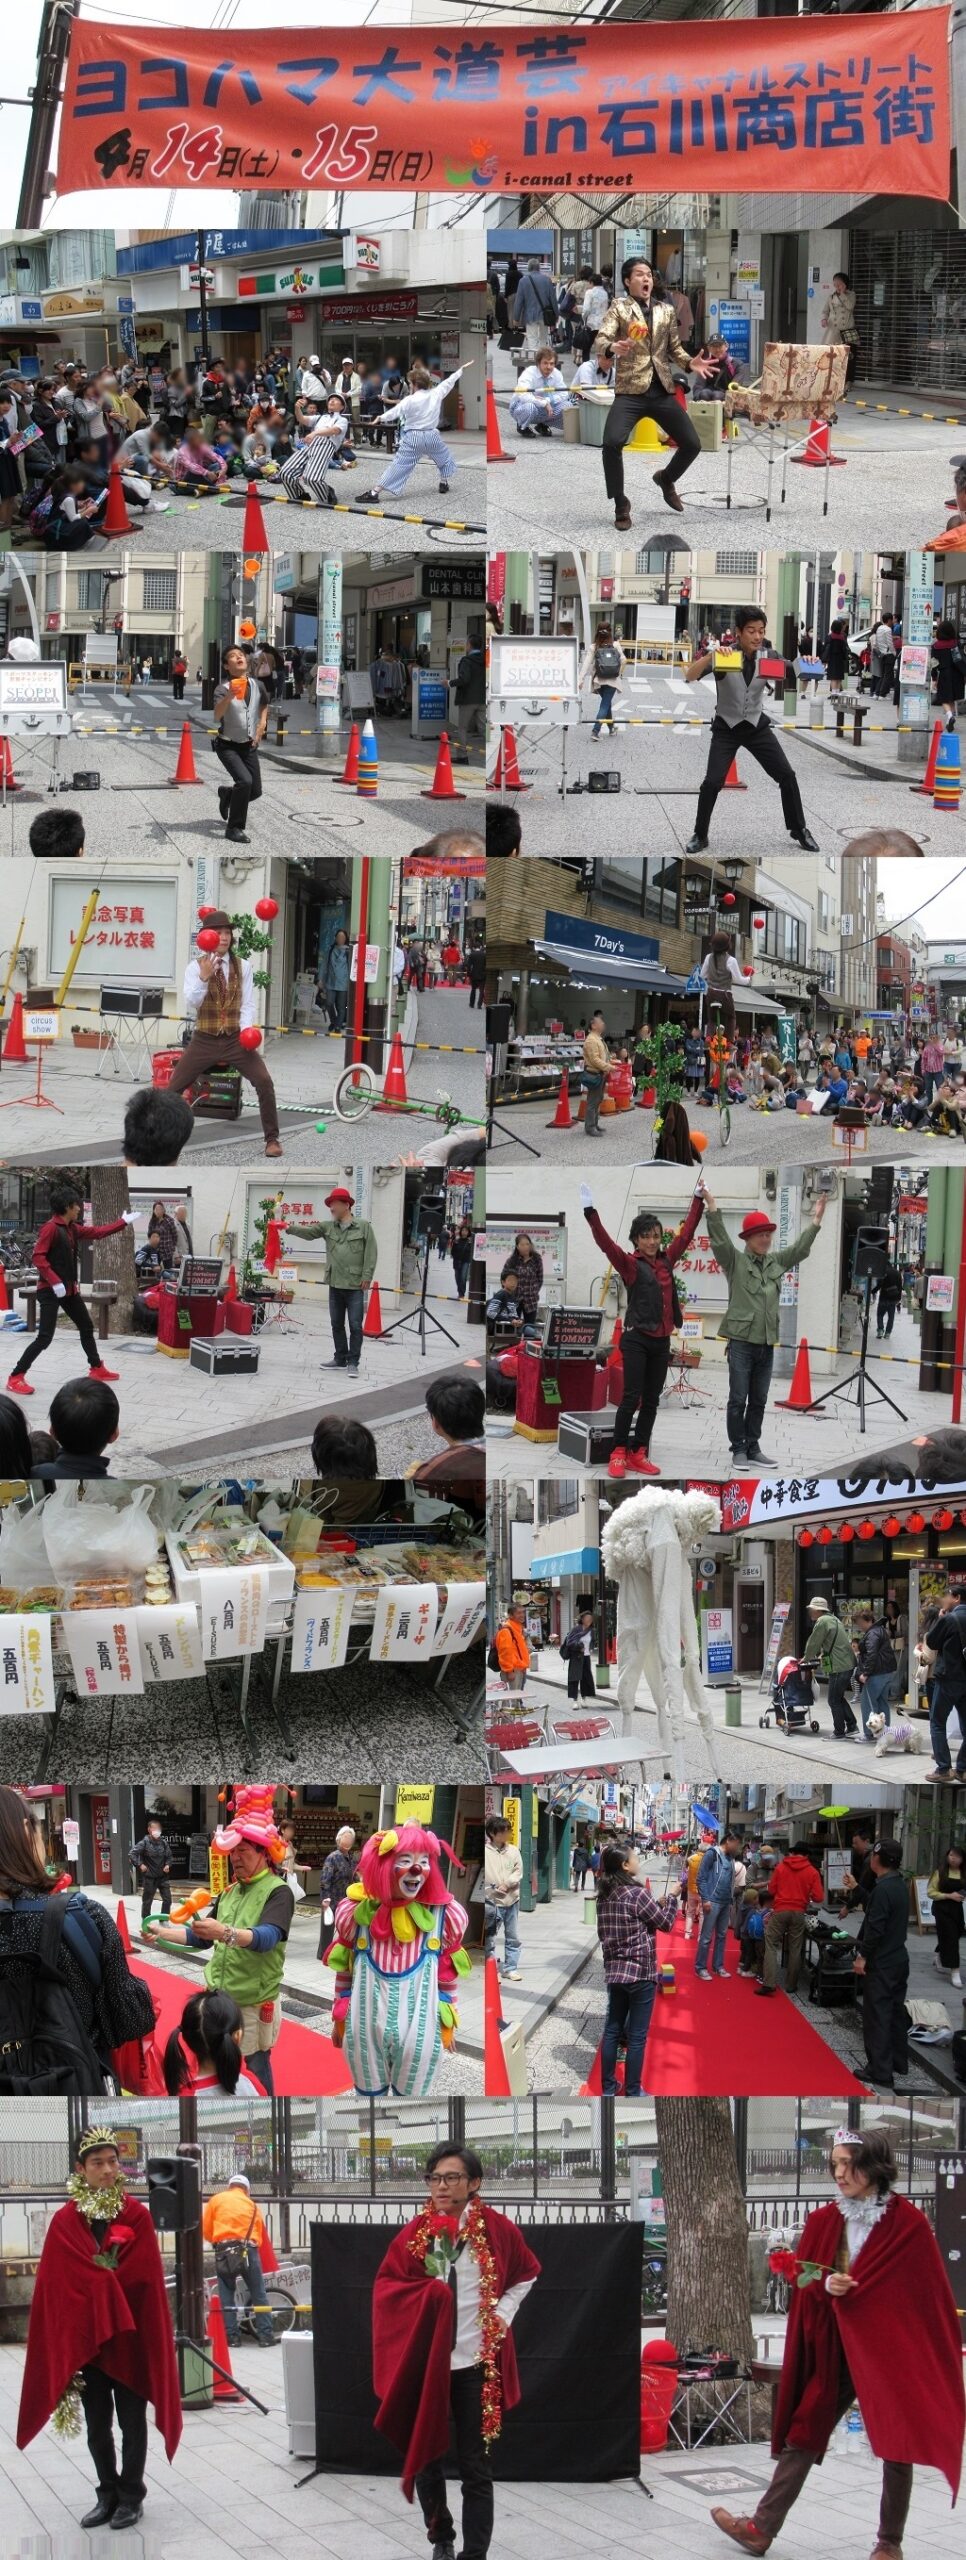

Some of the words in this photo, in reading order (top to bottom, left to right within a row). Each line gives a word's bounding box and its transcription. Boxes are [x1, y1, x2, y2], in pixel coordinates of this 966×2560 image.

[73, 35, 588, 118] ヨコハマ大道芸
[602, 54, 934, 98] アイキャナルストリート
[504, 171, 572, 187] i-canal
[576, 172, 634, 187] street
[429, 569, 463, 579] DENTAL
[70, 930, 155, 948] レンタル衣裳
[594, 934, 625, 953] 7Day's
[31, 1016, 53, 1024] circus
[760, 1479, 820, 1511] 中華食堂
[223, 1600, 235, 1630] 八百円
[396, 1611, 411, 1640] 三百円
[413, 1603, 430, 1645] ギョーザ
[158, 1634, 175, 1660] 五百円
[318, 1617, 335, 1647] 五百円
[2, 1648, 19, 1685] 五百円
[96, 1641, 113, 1671] 五百円
